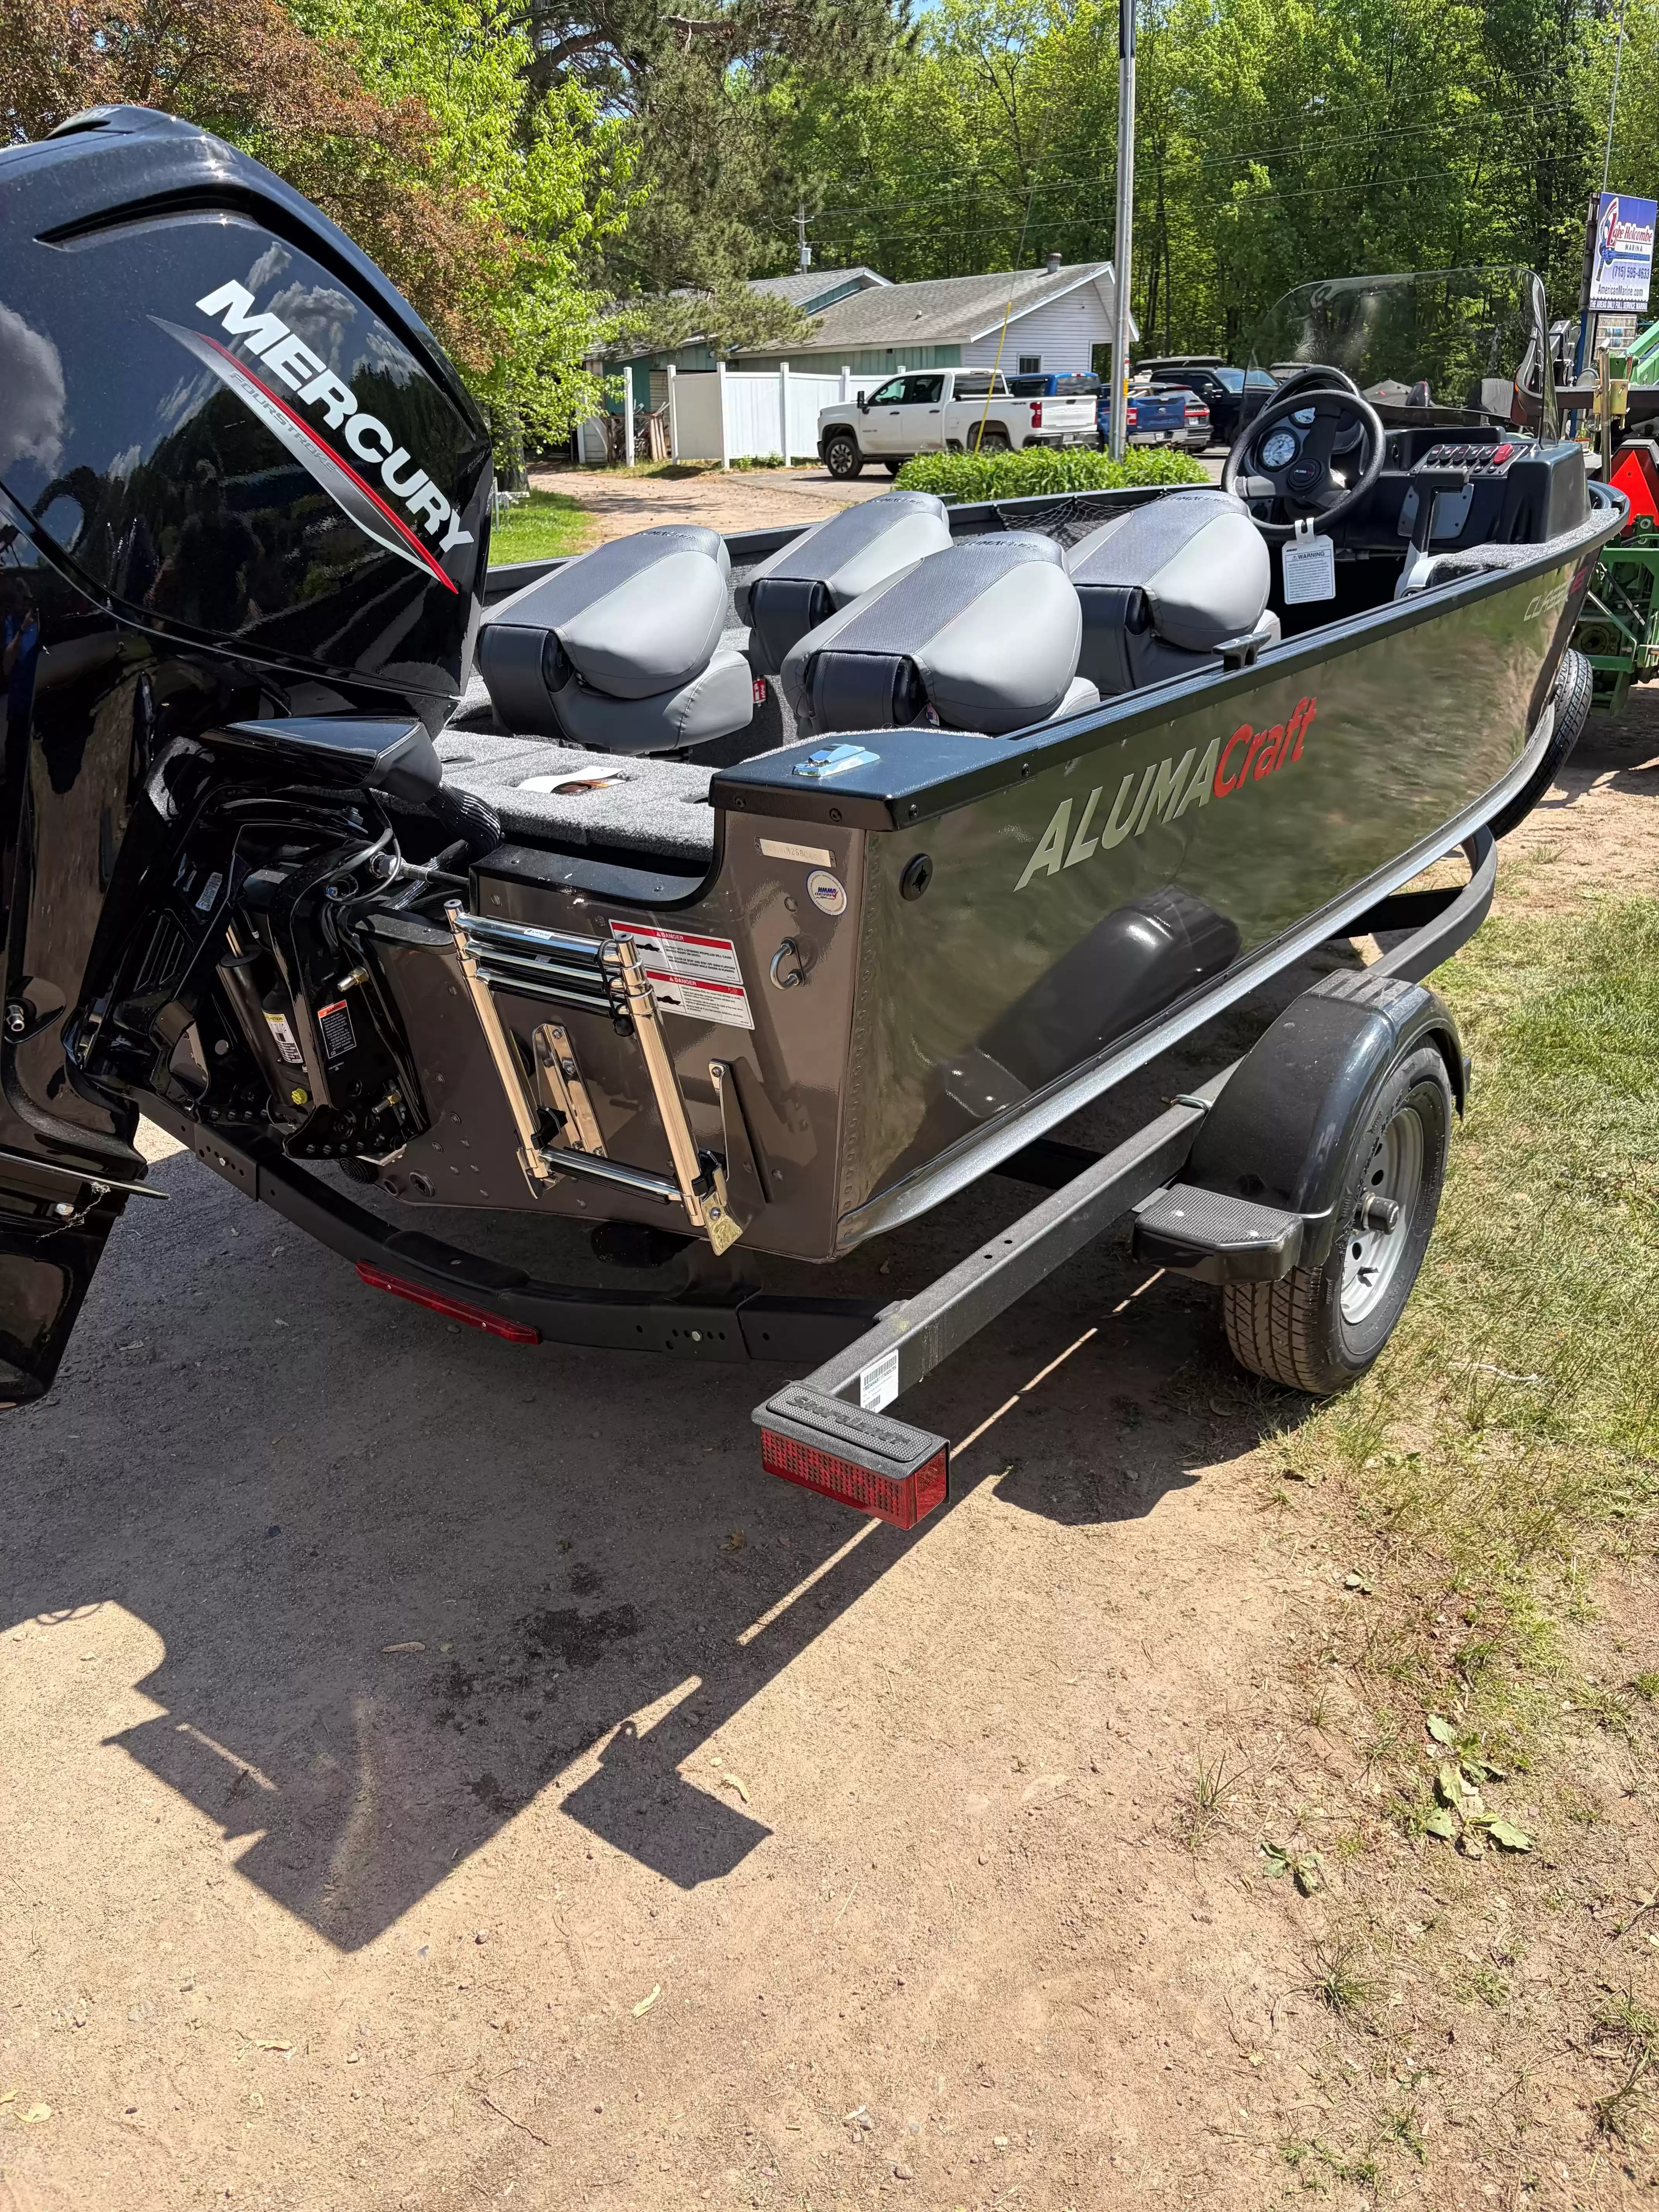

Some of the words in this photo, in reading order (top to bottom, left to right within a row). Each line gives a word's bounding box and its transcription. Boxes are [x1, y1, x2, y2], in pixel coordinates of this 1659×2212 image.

[1607, 212, 1624, 248] Lake
[1625, 226, 1652, 243] Holcombe
[1625, 244, 1643, 252] MARINA
[1613, 266, 1626, 280] (715)
[1626, 268, 1649, 279] 595-4633
[1598, 284, 1643, 297] AmericanMarine.com
[196, 280, 474, 553] MERCURY
[230, 371, 338, 472] FOURSTROKE
[1298, 551, 1325, 560] WARNING
[1013, 696, 1317, 892] ALUMACraft
[661, 932, 684, 941] DANGER
[675, 977, 697, 986] DANGER
